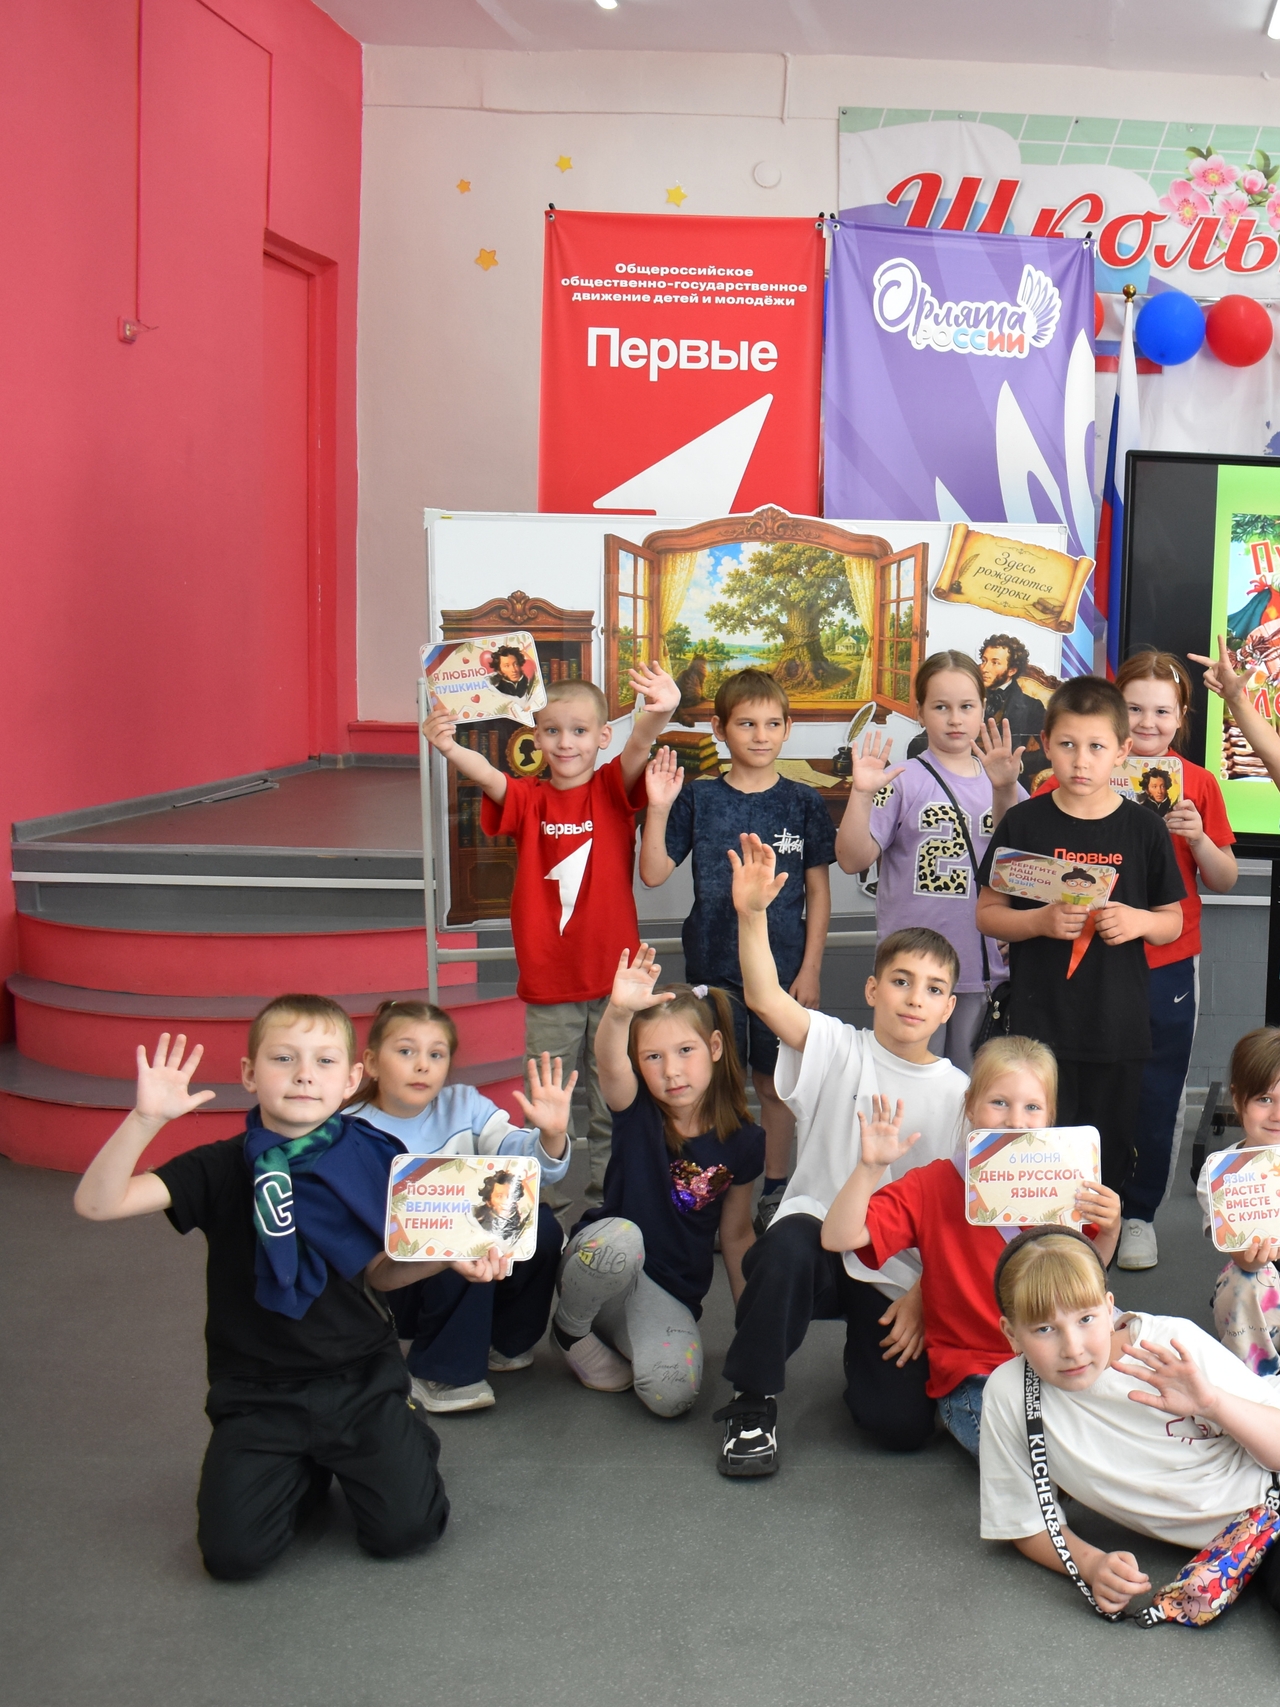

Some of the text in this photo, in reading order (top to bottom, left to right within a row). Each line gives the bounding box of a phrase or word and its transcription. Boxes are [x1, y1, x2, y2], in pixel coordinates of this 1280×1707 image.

[615, 263, 753, 278] Общероссийское
[561, 276, 808, 292] общественно-государственное
[571, 291, 795, 306] движение детей и молодёжи
[878, 262, 1027, 337] Орлята
[916, 325, 1024, 354] РОССИИ
[587, 327, 778, 382] Первые
[995, 552, 1036, 574] Здесь
[973, 566, 1053, 593] рождаются
[984, 582, 1032, 601] строки
[434, 668, 486, 681] Я ЛЮБЛЮ
[435, 680, 489, 695] ПУШКИНА
[1109, 778, 1129, 787] НЦЕ
[1054, 848, 1123, 865] Первые
[1010, 866, 1034, 876] НАШ
[1011, 860, 1057, 876] БЕРЕГИТЕ
[1008, 878, 1035, 888] ЯЗЫК
[1009, 871, 1051, 886] РОДНОЙ
[1009, 1152, 1061, 1164] 6 ИЮНЯ
[979, 1170, 1014, 1183] ДЕНЬ
[1223, 1172, 1256, 1185] ЯЗЫК
[407, 1184, 465, 1196] ПОЭЗИИ
[1011, 1187, 1058, 1199] ЯЗЫКА
[1224, 1184, 1266, 1197] РАСТЕТ
[406, 1199, 471, 1213] ВЕЛИКИЙ
[1226, 1196, 1271, 1209] ВМЕСТЕ
[405, 1215, 453, 1230] ГЕНИЙ!
[1228, 1213, 1236, 1223] С
[1026, 1372, 1034, 1420] FASHION
